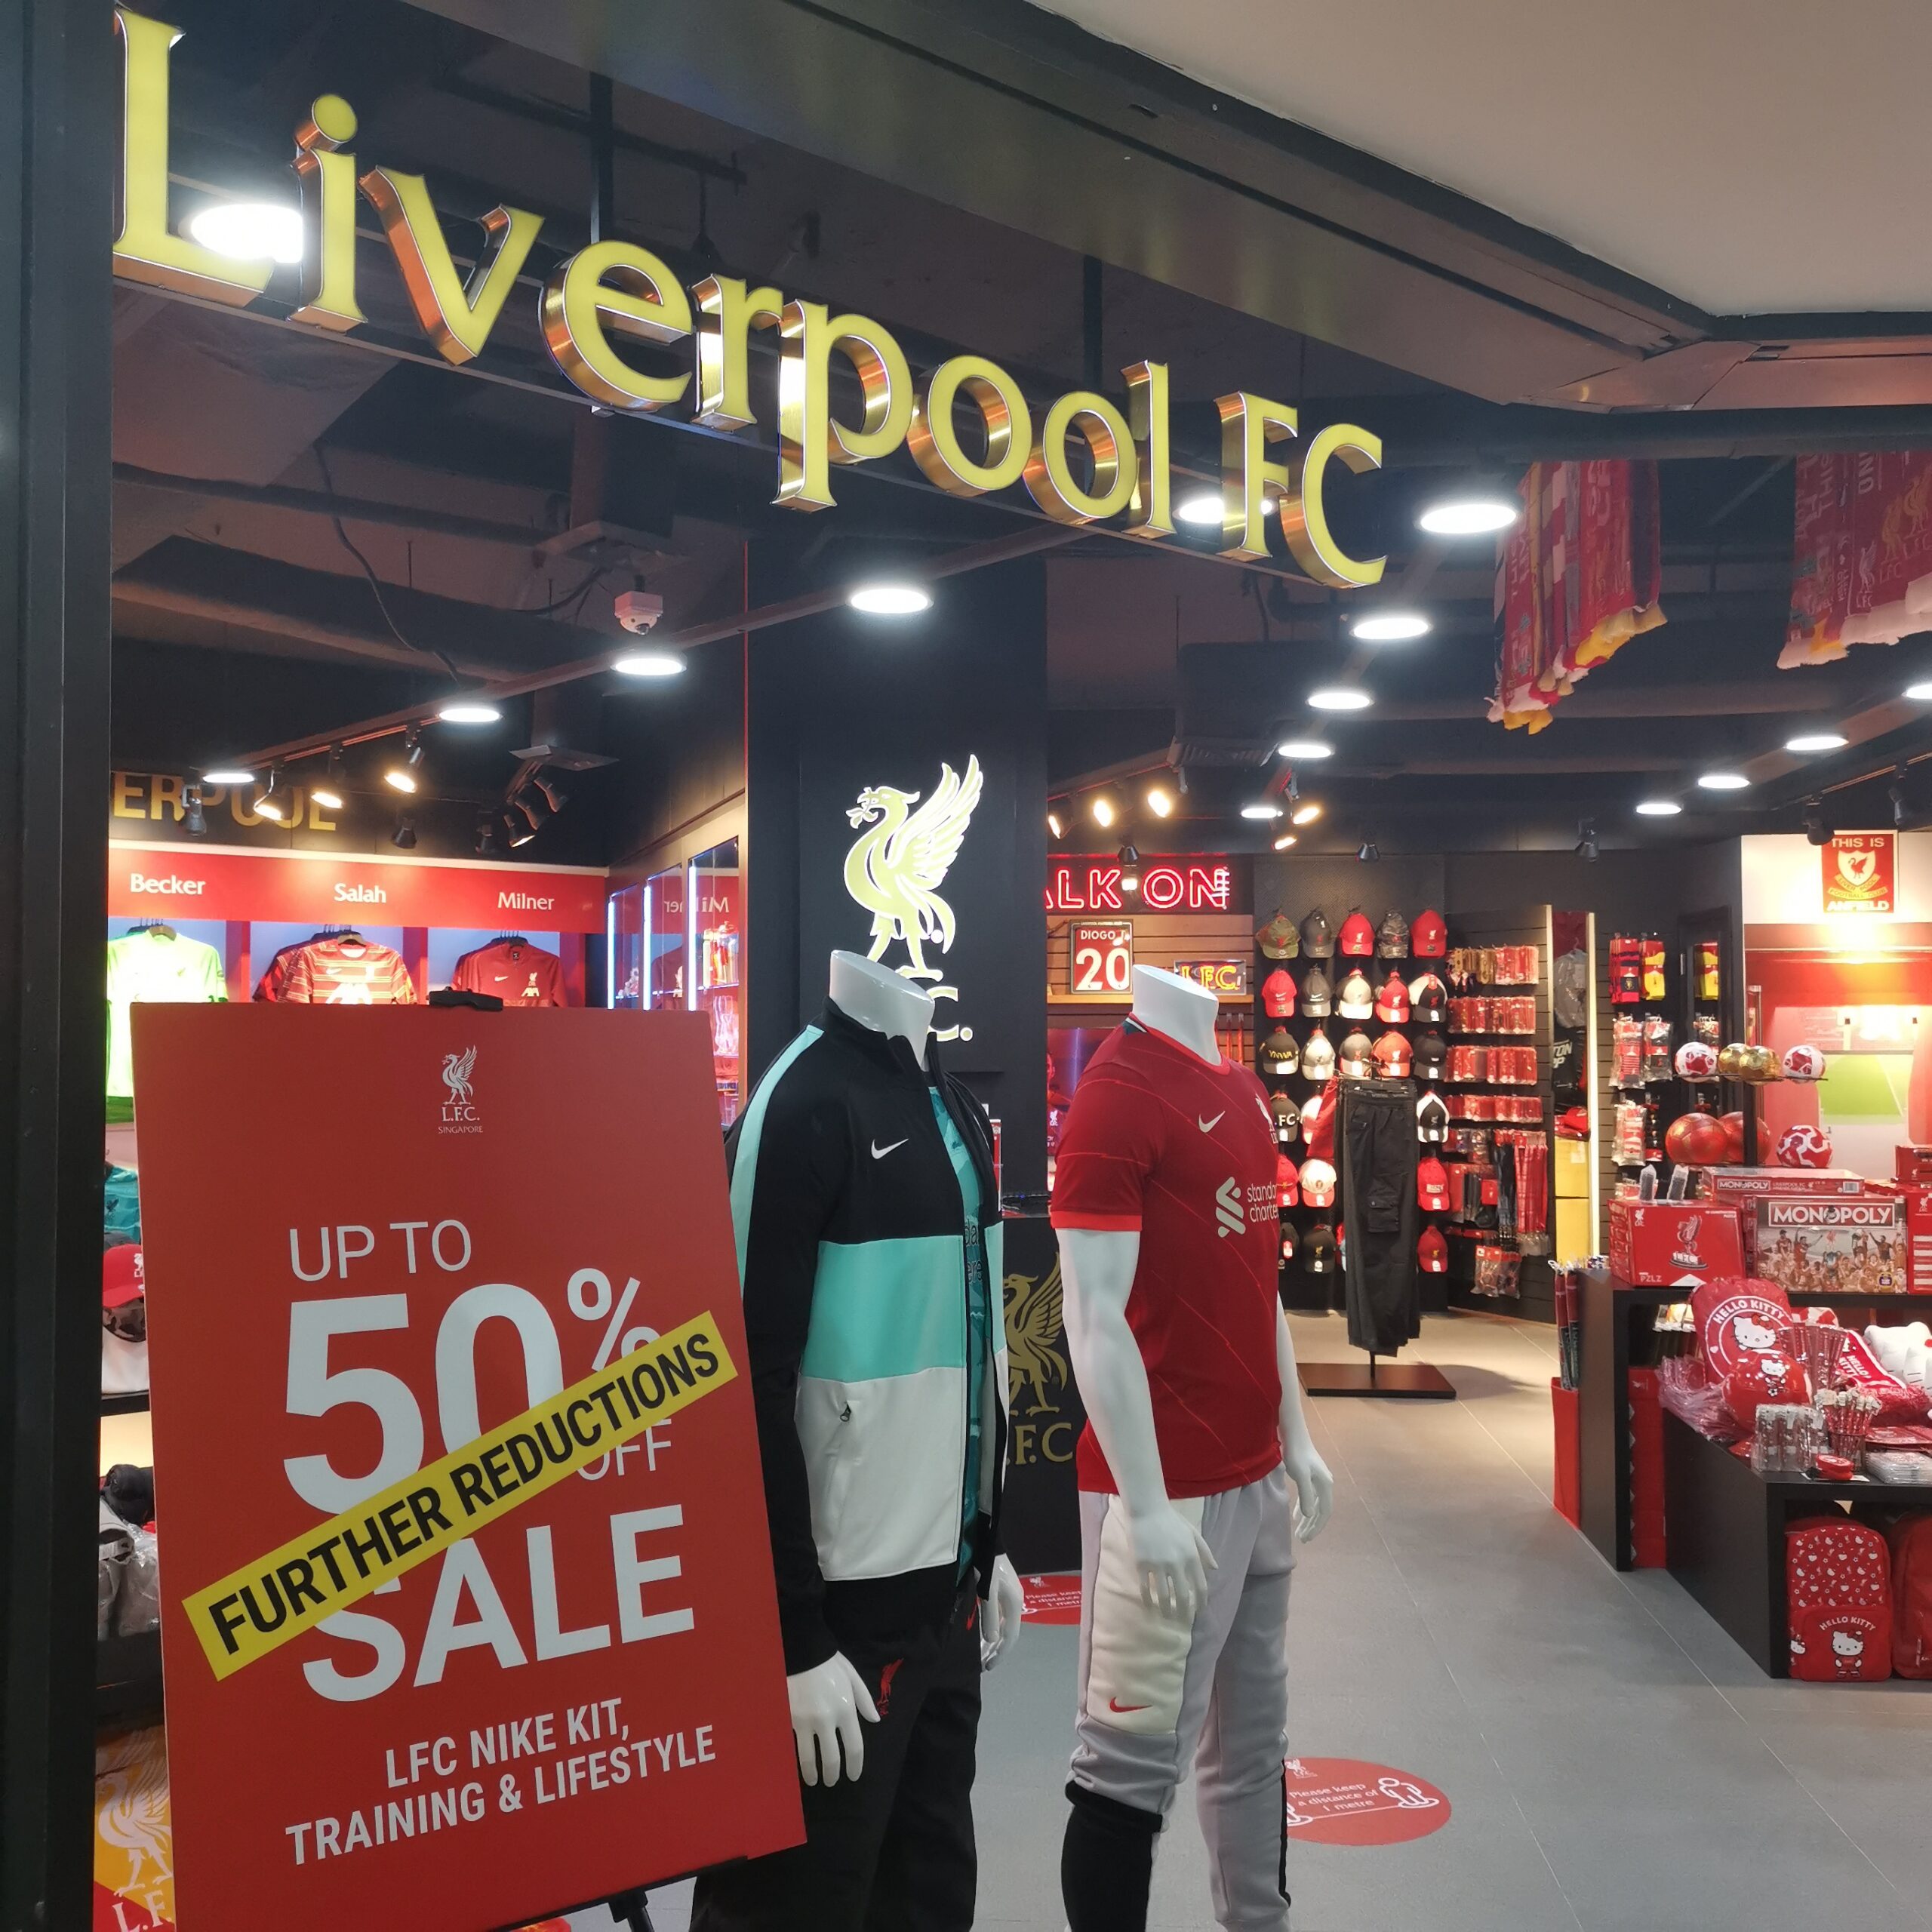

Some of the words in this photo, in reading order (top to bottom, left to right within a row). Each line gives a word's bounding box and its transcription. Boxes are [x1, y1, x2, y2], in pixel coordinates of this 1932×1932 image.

[113, 9, 1177, 537] Liverpool
[1217, 391, 1387, 590] FC
[1832, 838, 1863, 848] THIS
[1870, 837, 1884, 848] IS
[130, 872, 206, 895] Becker
[334, 883, 387, 905] Salah
[1143, 868, 1227, 909] ON
[497, 891, 555, 911] Milner
[1080, 930, 1115, 940] DIOGO
[1075, 947, 1130, 991] 20
[438, 1125, 483, 1135] SINGAPORE
[1278, 1113, 1296, 1127] FC
[1720, 1180, 1769, 1189] MONOPOLY
[1773, 1205, 1892, 1224] MONOPOLY
[290, 1224, 375, 1282] UP
[389, 1219, 472, 1275] TO
[1713, 1299, 1749, 1324] HELLO
[1750, 1299, 1785, 1319] KITTY
[208, 1486, 454, 1657] FURTHER
[448, 1332, 721, 1515] REDUCTIONS
[303, 1503, 696, 1703] SALE
[1819, 1616, 1849, 1632] HELLO
[1850, 1616, 1876, 1632] KITTY
[386, 1736, 457, 1789] LFC
[469, 1712, 558, 1770] NIKE
[566, 1697, 630, 1746] KIT,
[285, 1781, 485, 1866] TRAINING
[498, 1772, 525, 1814] &
[534, 1724, 717, 1805] LIFESTYLE
[1289, 1789, 1333, 1799] Please
[1331, 1783, 1367, 1793] keep
[1308, 1792, 1363, 1805] distance
[1364, 1789, 1380, 1798] of
[1334, 1799, 1375, 1810] metre
